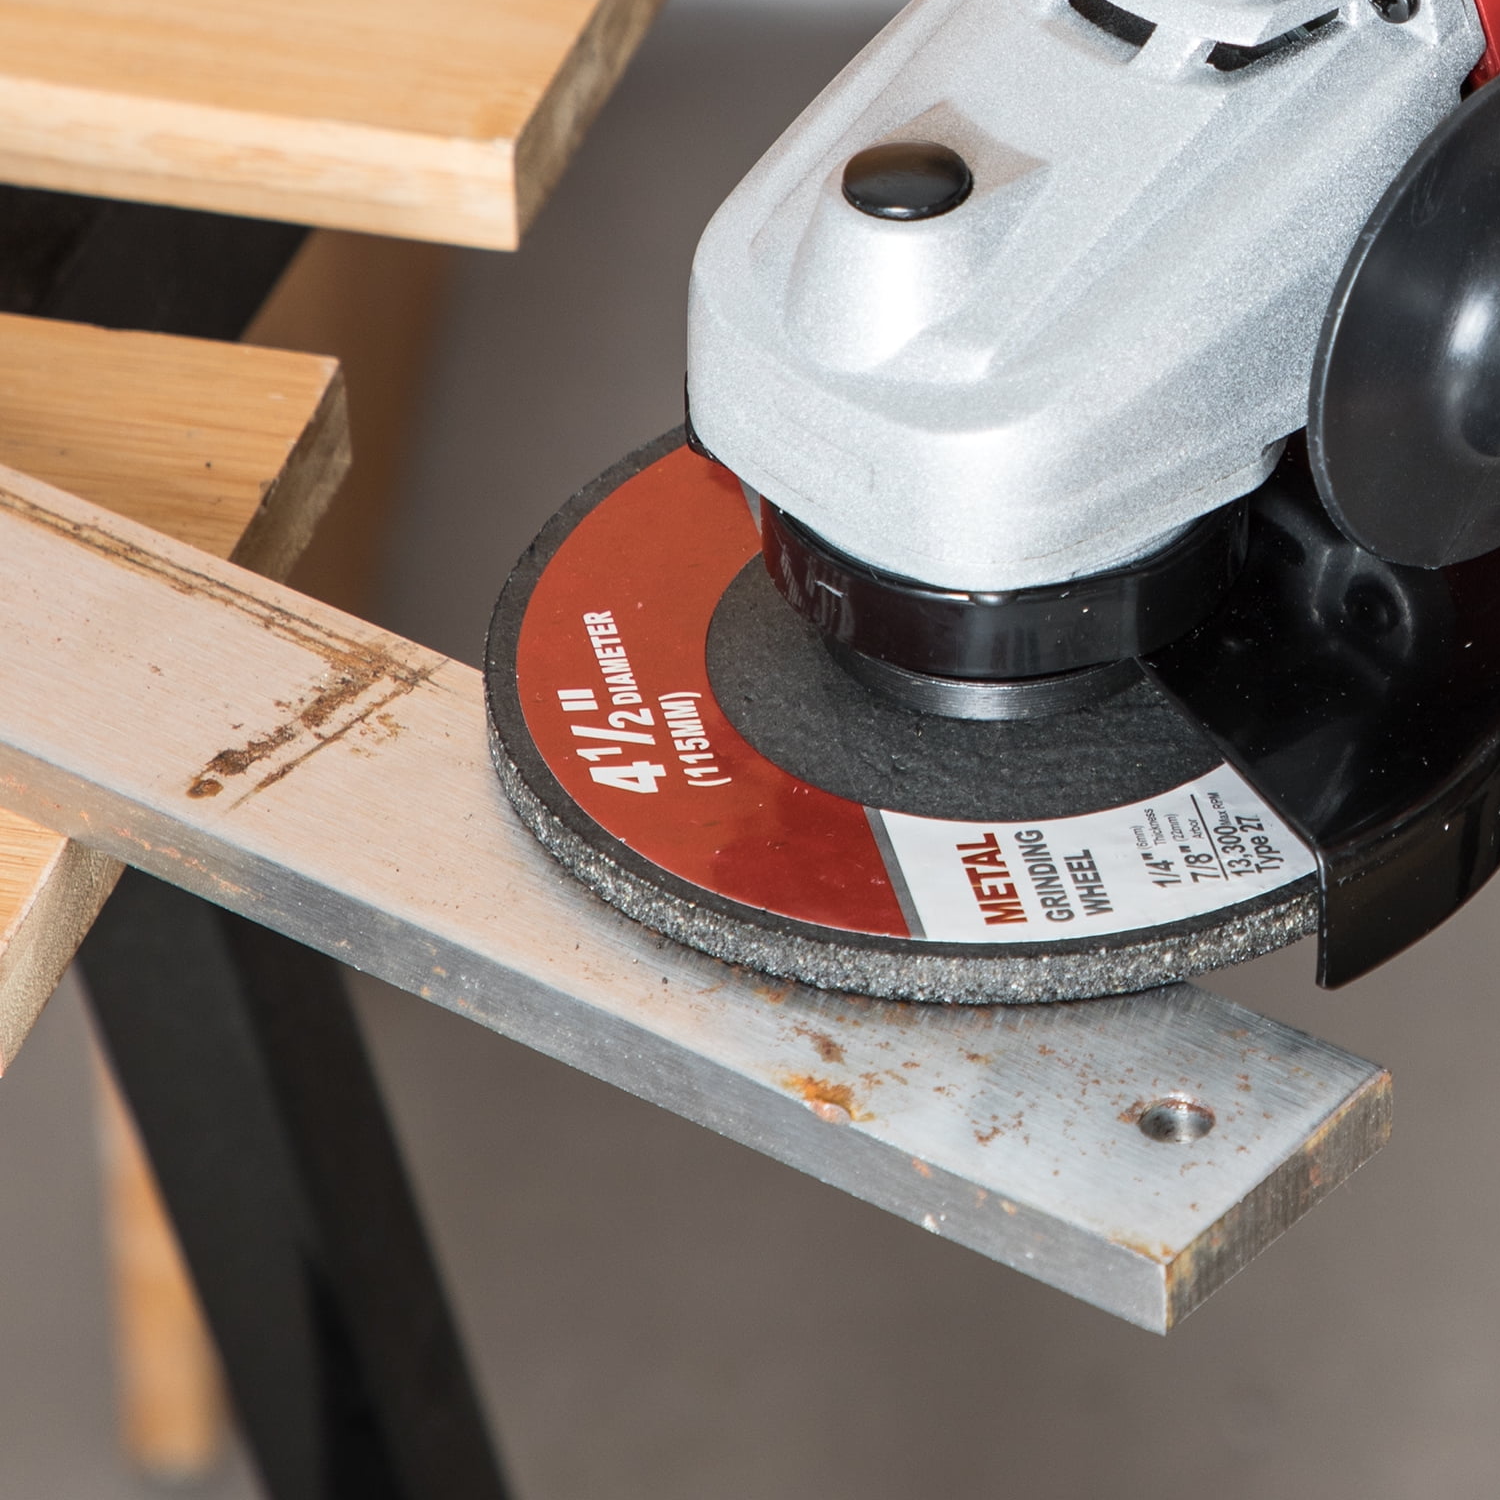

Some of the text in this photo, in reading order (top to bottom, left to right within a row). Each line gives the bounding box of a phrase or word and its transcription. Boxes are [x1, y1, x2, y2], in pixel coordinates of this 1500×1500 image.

[582, 610, 643, 705] DIAMETER
[658, 691, 732, 787] (115MM)
[1129, 825, 1182, 888] 1/4" (6mm)
[1144, 808, 1167, 846] Thickness
[1164, 813, 1221, 883] 7/8" (22mm)
[1188, 818, 1204, 840] Arbor
[1207, 792, 1256, 877] 13,300 Max RPM
[1234, 815, 1285, 874] Type 27
[956, 832, 1029, 926] METAL
[1015, 829, 1075, 923] GRINDING
[1064, 848, 1114, 917] WHEEL
